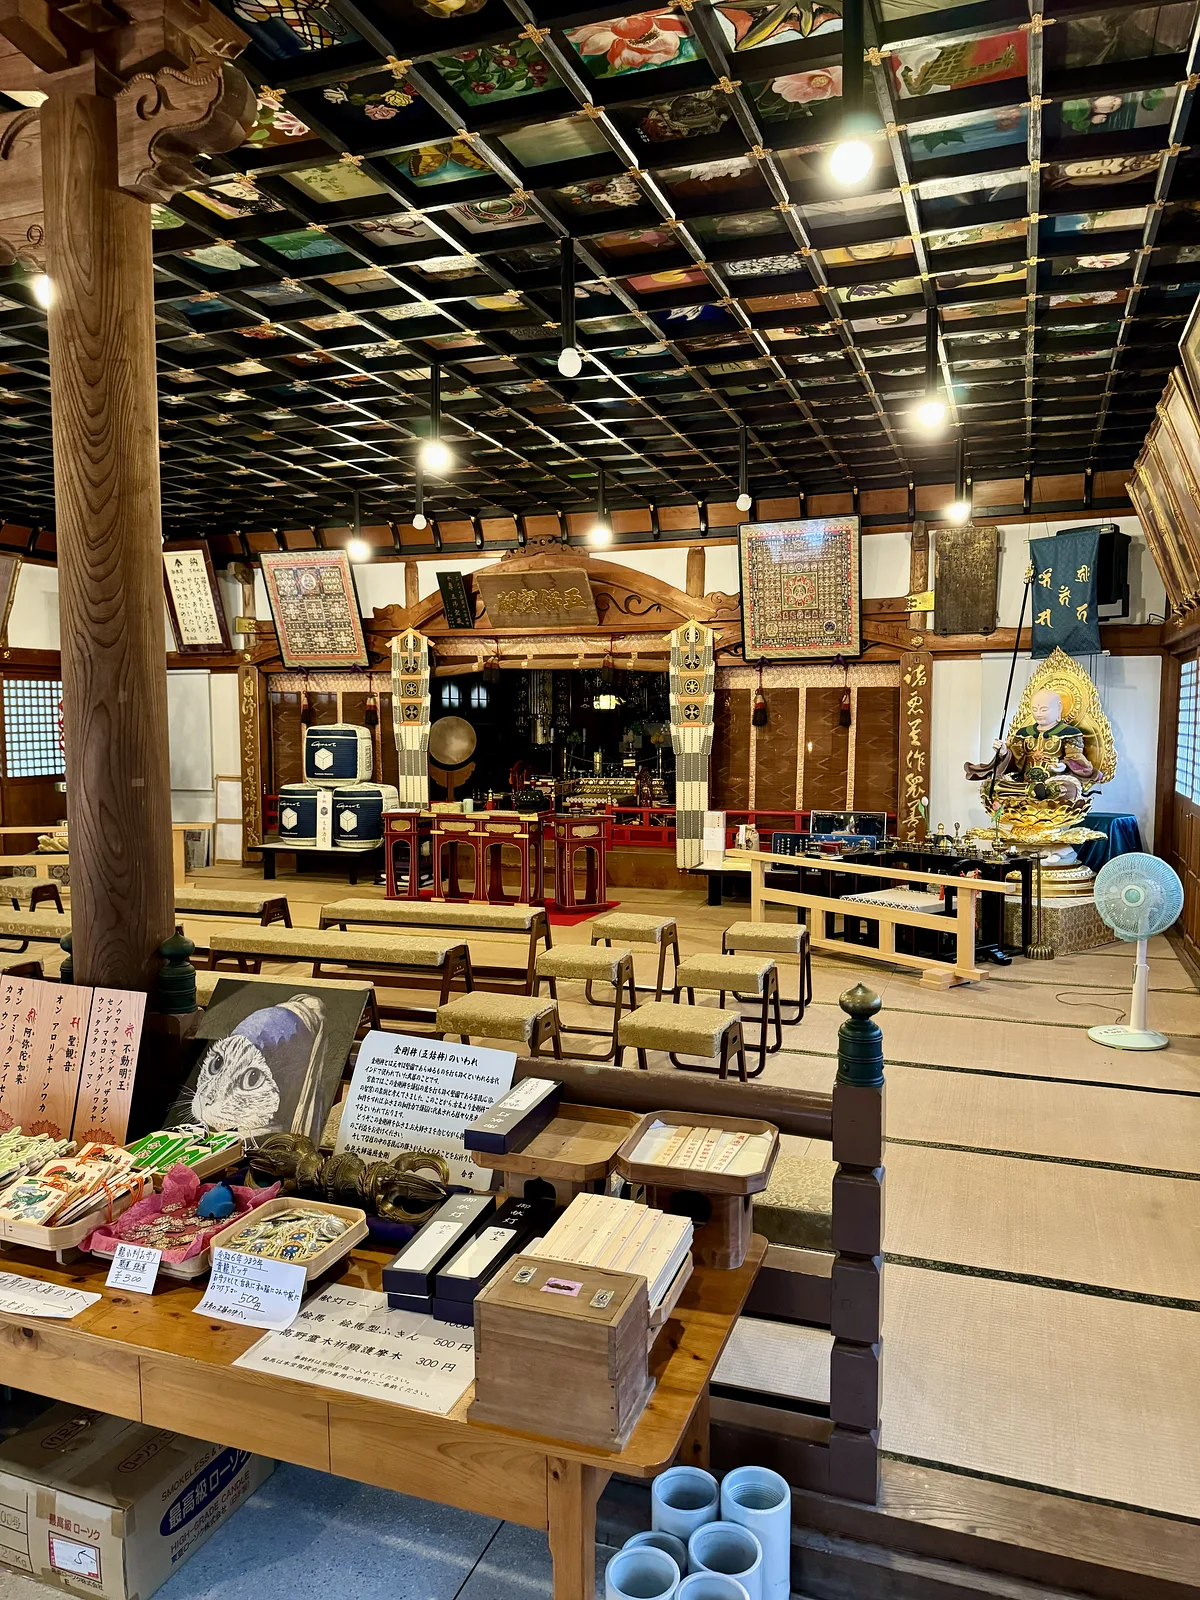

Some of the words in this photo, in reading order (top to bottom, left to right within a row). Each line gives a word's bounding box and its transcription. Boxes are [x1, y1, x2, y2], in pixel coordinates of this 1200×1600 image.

[4, 985, 13, 1004] カラ
[16, 986, 24, 1006] オン
[55, 995, 64, 1014] オン
[6, 1014, 19, 1055] アミリタ
[15, 1027, 33, 1085] 阿弥陀如来
[63, 1035, 77, 1072] 聖観音
[117, 1044, 132, 1091] 不動明王
[38, 1082, 50, 1112] ソワカ
[433, 1337, 456, 1350] 500
[457, 1342, 473, 1353] 円
[416, 1357, 439, 1369] 300
[442, 1362, 457, 1373] 円
[161, 1453, 209, 1502] SMOKELESS
[170, 1501, 220, 1554] HIGH-GRADE
[221, 1470, 250, 1503] CANDLE
